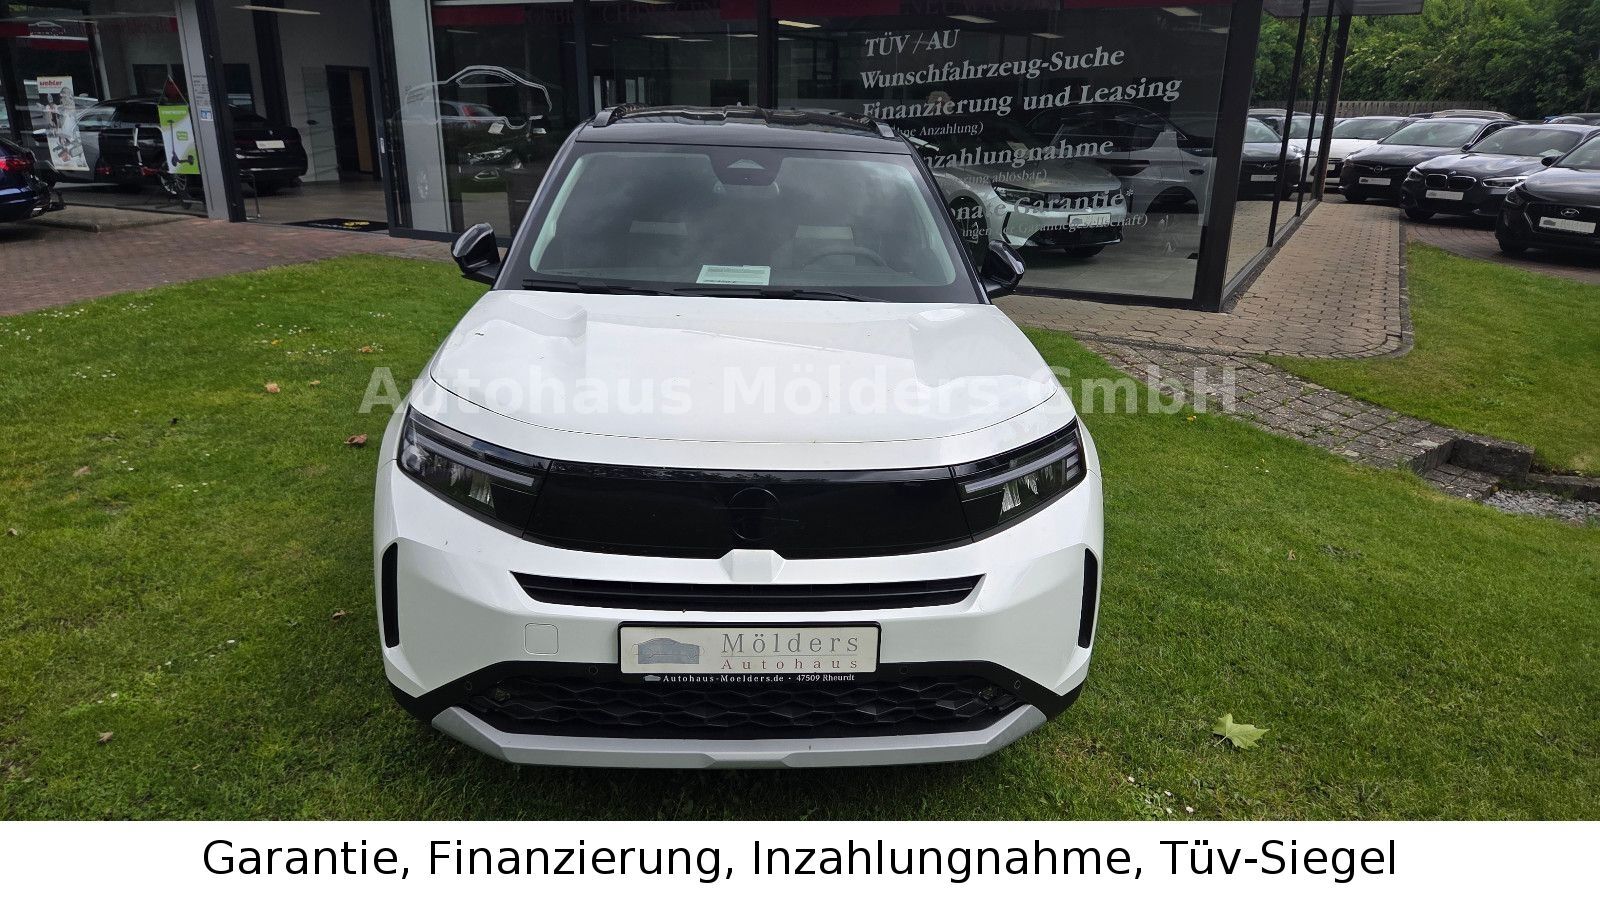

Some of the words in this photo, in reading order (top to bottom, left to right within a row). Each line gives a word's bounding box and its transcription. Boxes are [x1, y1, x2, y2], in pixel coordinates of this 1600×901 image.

[865, 32, 910, 57] TÜV
[925, 29, 960, 50] AU
[860, 46, 1125, 89] Wunschfahrzeug-Suche
[863, 95, 1013, 120] Finanzierung
[1023, 86, 1071, 110] und
[1078, 77, 1183, 102] Leasing
[919, 121, 983, 136] Anzahlung)
[923, 139, 1114, 169] nzahlungnahme
[720, 633, 859, 654] Mölders
[720, 658, 858, 670] Autohaus
[663, 674, 784, 683] Autohaus-Moelders.de
[796, 674, 820, 682] 47509
[822, 673, 855, 682] Rheurdt
